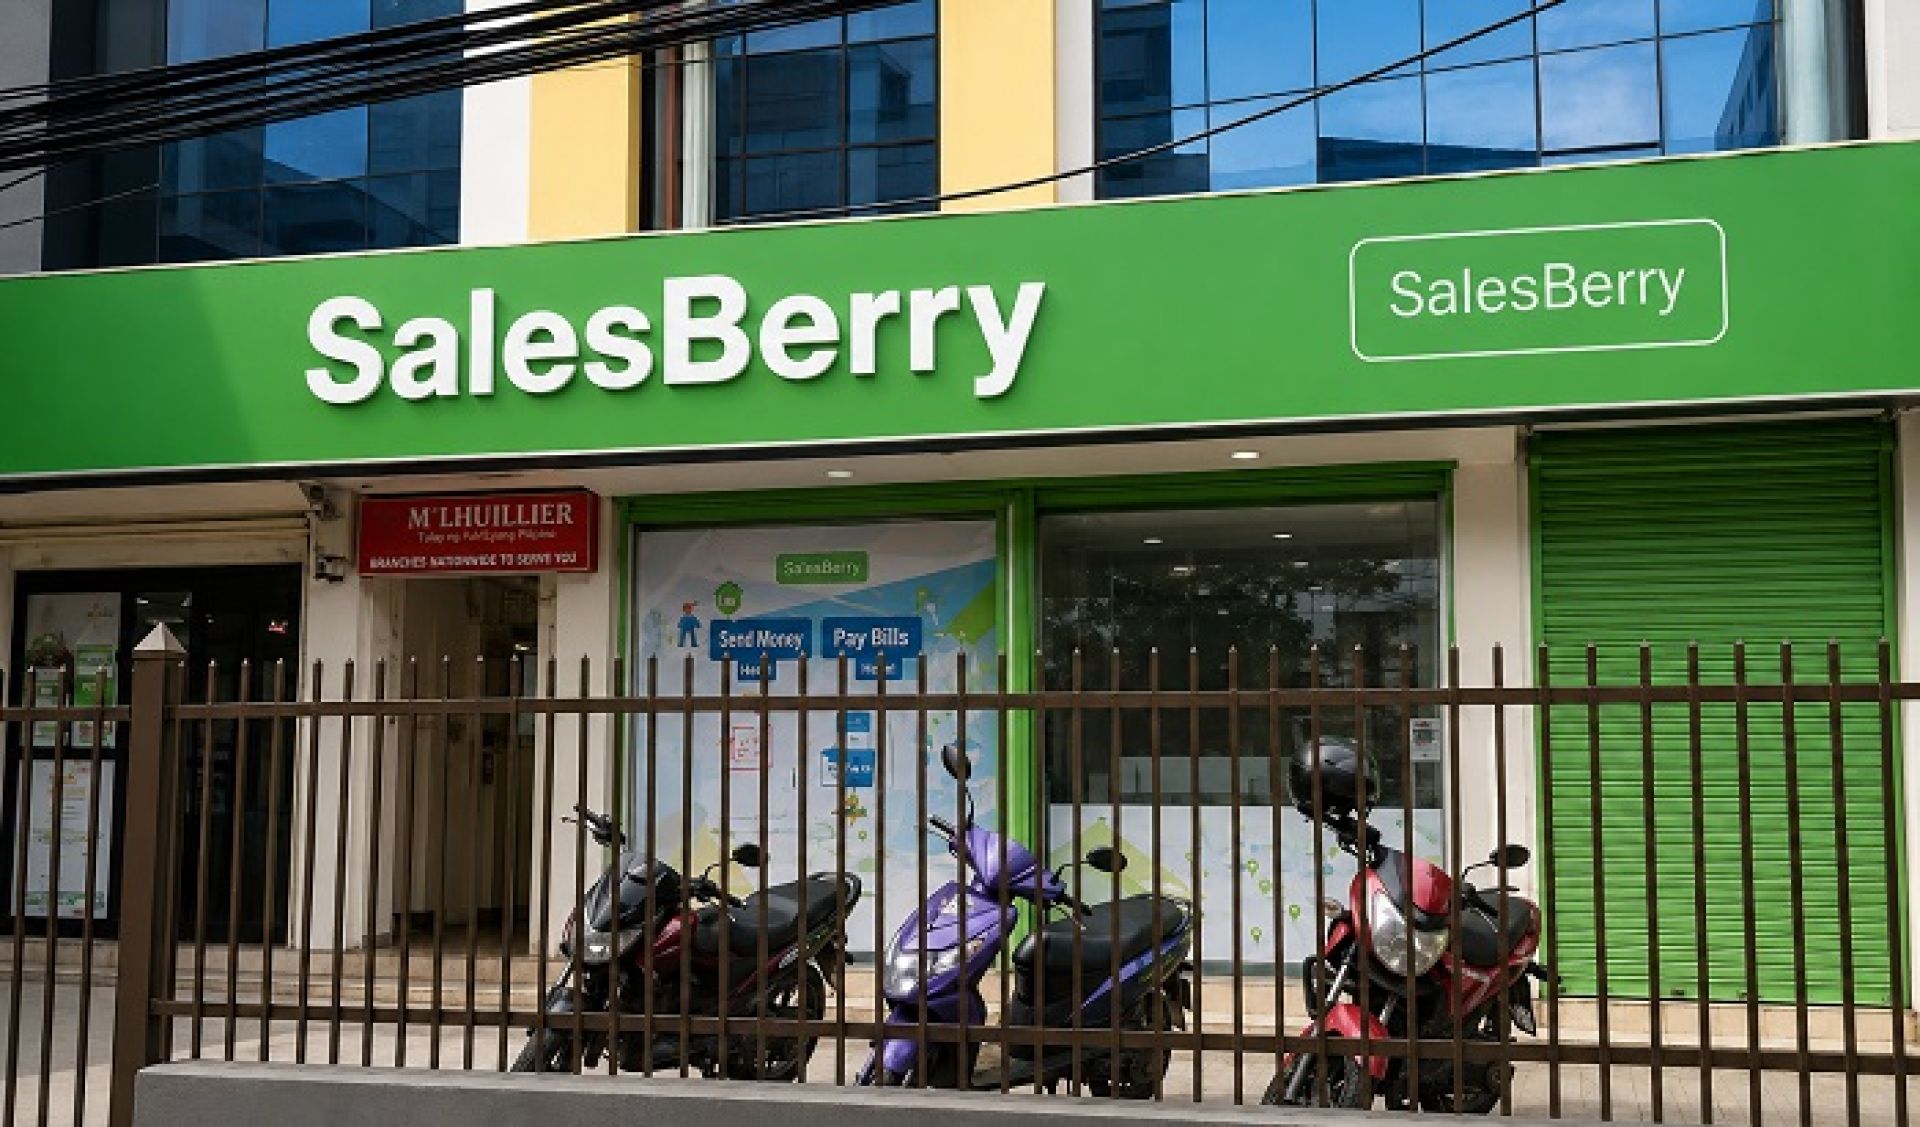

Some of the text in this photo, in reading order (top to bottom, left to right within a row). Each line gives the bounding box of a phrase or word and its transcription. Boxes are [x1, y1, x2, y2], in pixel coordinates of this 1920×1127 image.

[1389, 262, 1686, 318] SalesBerry
[304, 274, 1046, 404] SalesBerry
[500, 553, 514, 566] TO
[553, 550, 577, 563] YOU
[718, 630, 805, 650] Send Money
[833, 627, 909, 650] Pay Bills
